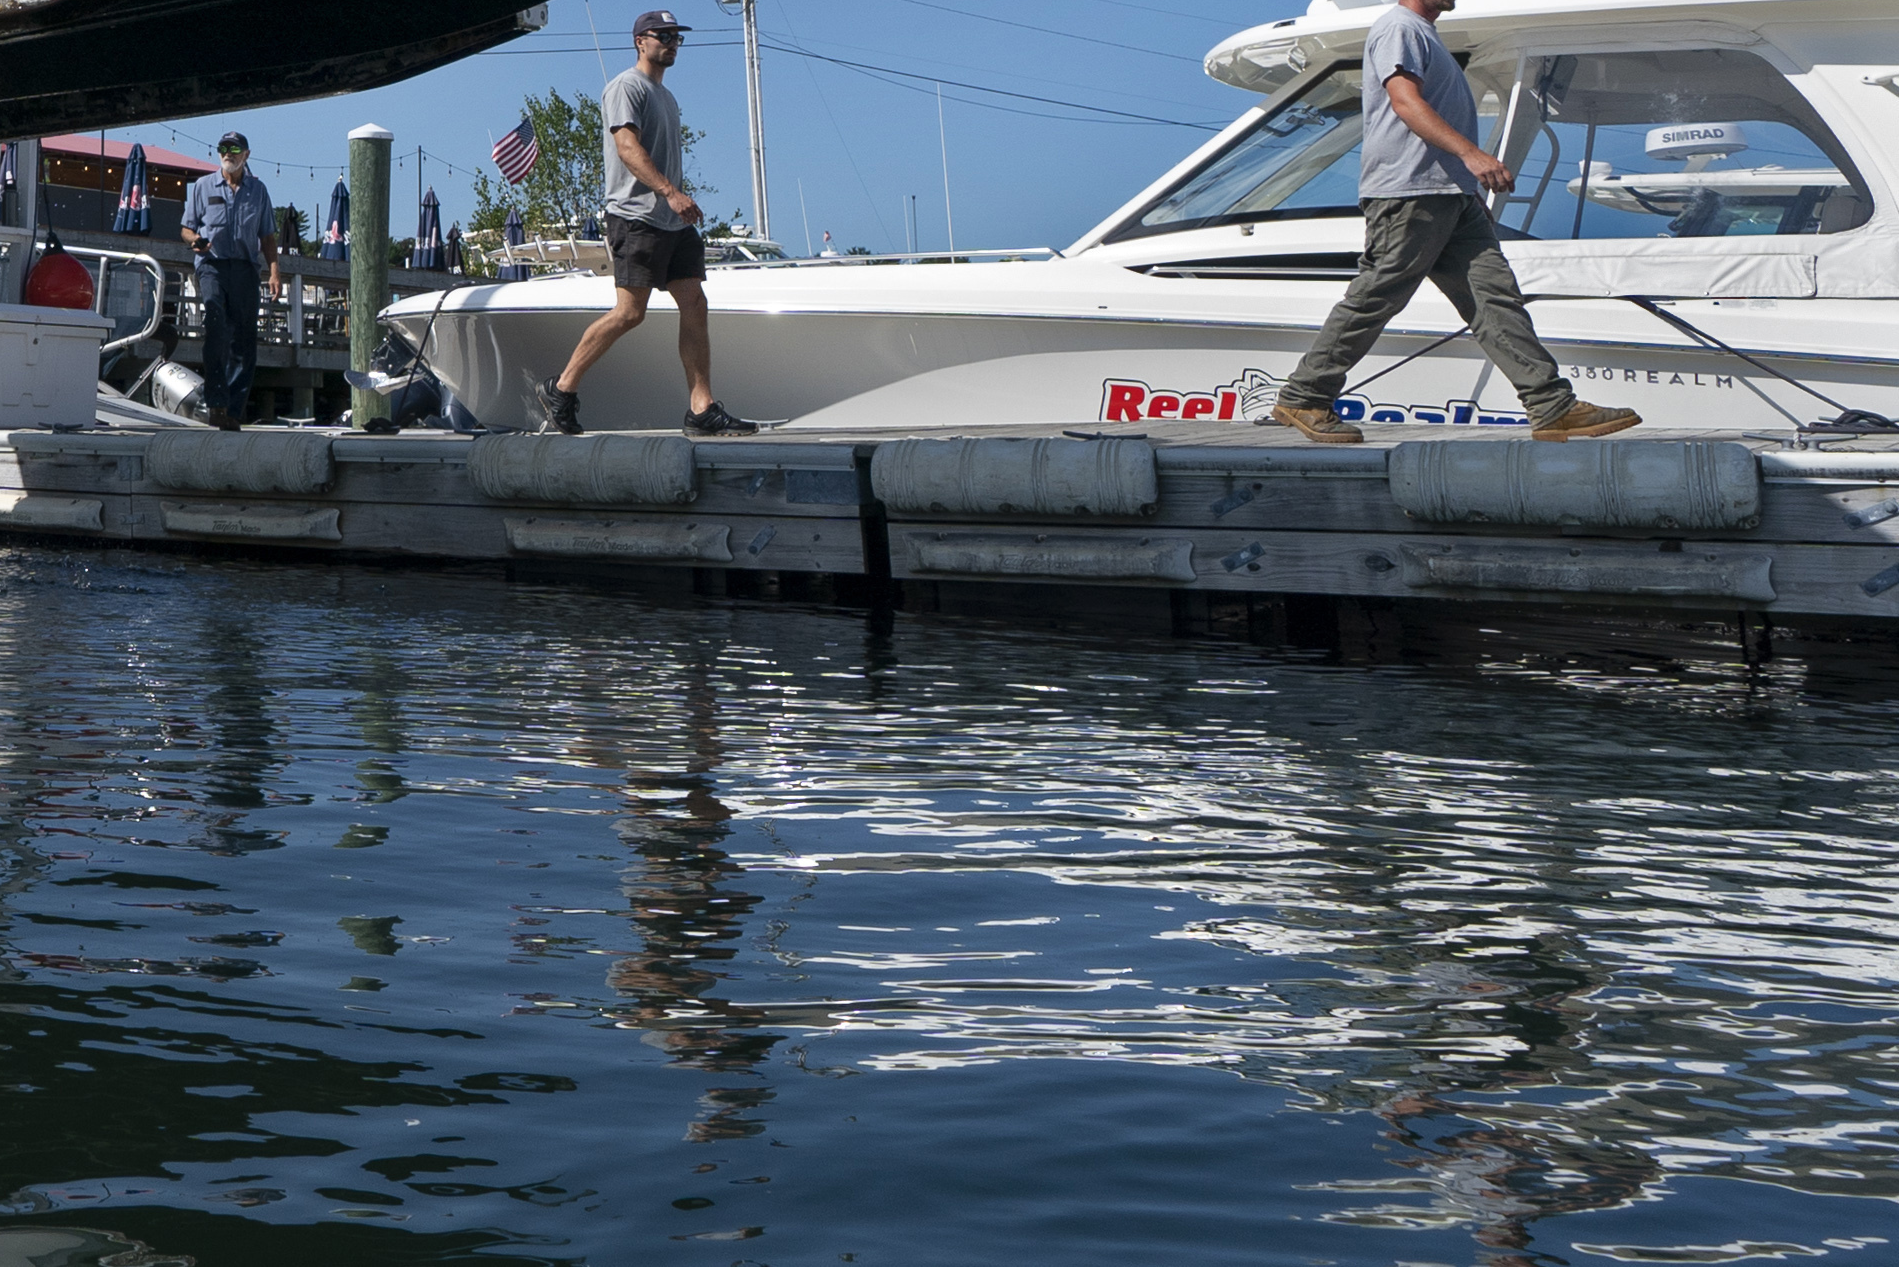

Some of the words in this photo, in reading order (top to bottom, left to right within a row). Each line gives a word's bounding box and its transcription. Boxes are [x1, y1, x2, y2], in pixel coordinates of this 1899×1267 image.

[1662, 128, 1725, 143] SIMRAD
[1570, 365, 1613, 380] 350
[1624, 369, 1733, 389] REALM
[1107, 384, 1238, 422] Reel
[572, 536, 608, 551] Taylor
